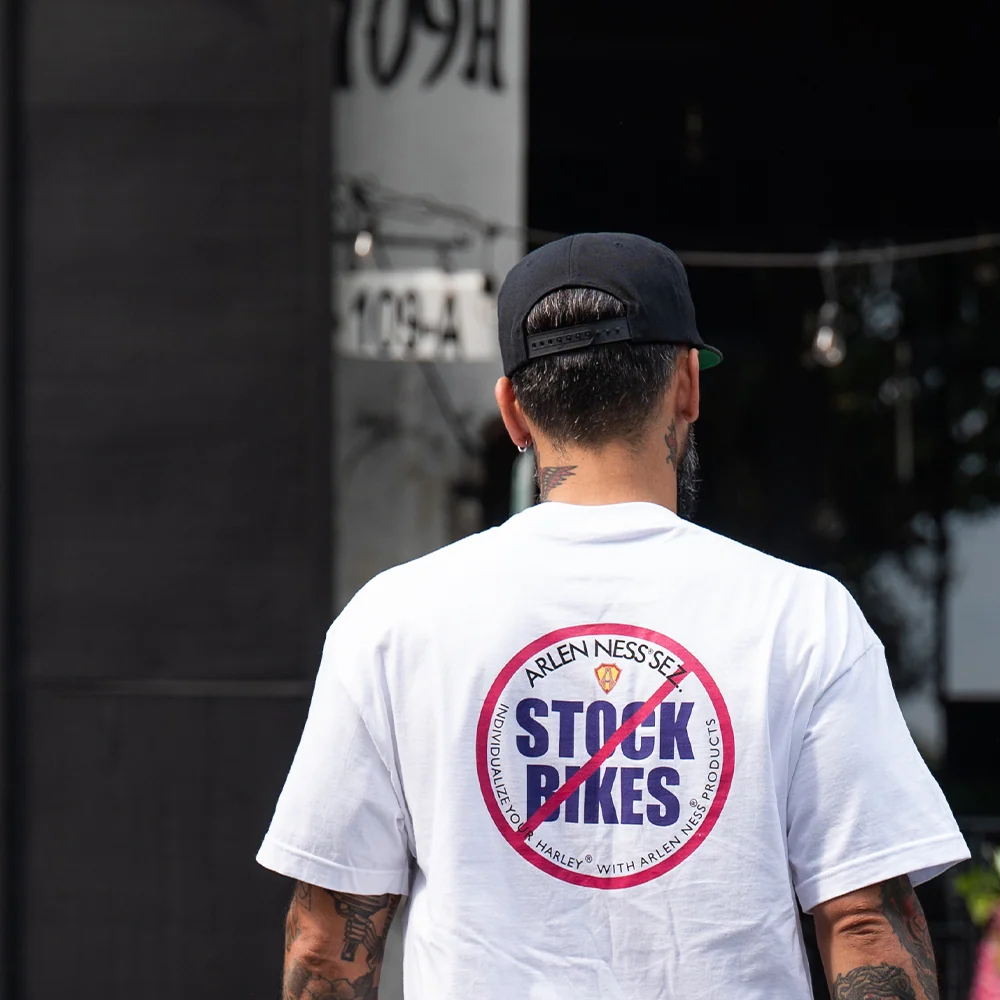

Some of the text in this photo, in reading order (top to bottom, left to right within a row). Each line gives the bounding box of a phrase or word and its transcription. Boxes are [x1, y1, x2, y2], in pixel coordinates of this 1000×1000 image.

[525, 640, 589, 688] ARLEN
[515, 697, 695, 761] STOCK
[490, 703, 510, 806] INDIVIDUALIZE
[505, 804, 534, 841] YOUR
[597, 861, 635, 875] WITH
[640, 835, 681, 868] ARLEN
[701, 718, 721, 801] PRODUCTS
[526, 764, 680, 827] BIKES
